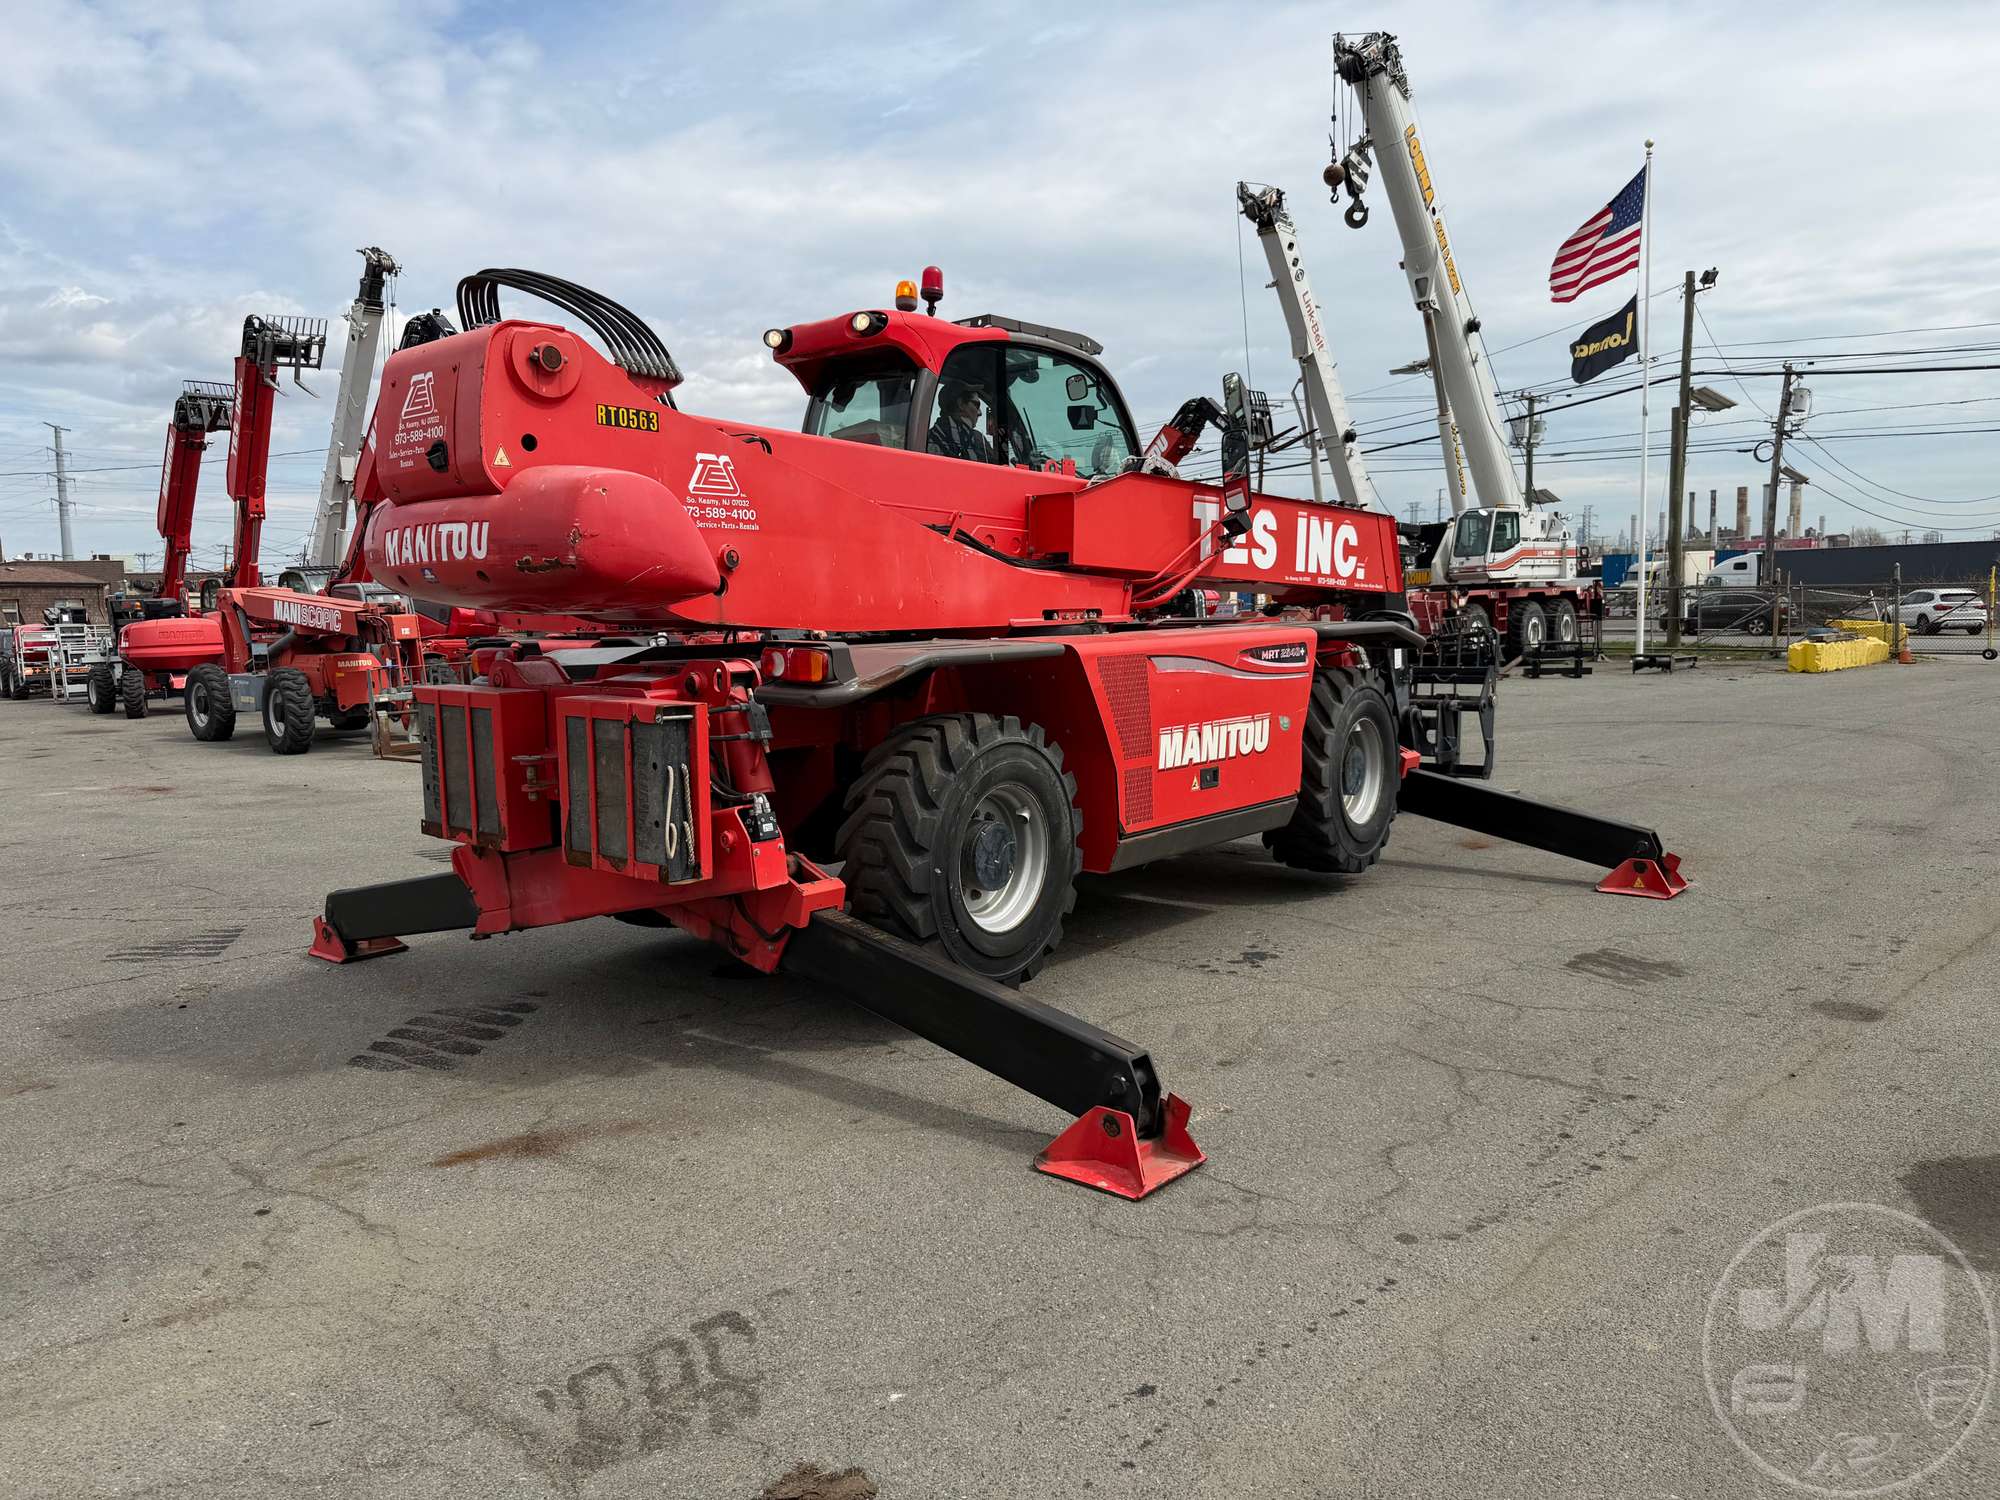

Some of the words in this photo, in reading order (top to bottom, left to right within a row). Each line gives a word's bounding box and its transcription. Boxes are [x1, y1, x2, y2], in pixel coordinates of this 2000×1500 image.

[1404, 123, 1434, 211] LOMMA
[1302, 290, 1325, 352] Link-Belt
[395, 425, 443, 445] 973-589-4100
[722, 498, 730, 506] NJ
[385, 521, 490, 567] MANITOU
[1295, 511, 1367, 580] INC.
[273, 600, 342, 632] MANISCOPIC
[337, 659, 372, 668] MANITOU
[1261, 649, 1280, 659] MRT
[1158, 712, 1271, 771] MANITOU
